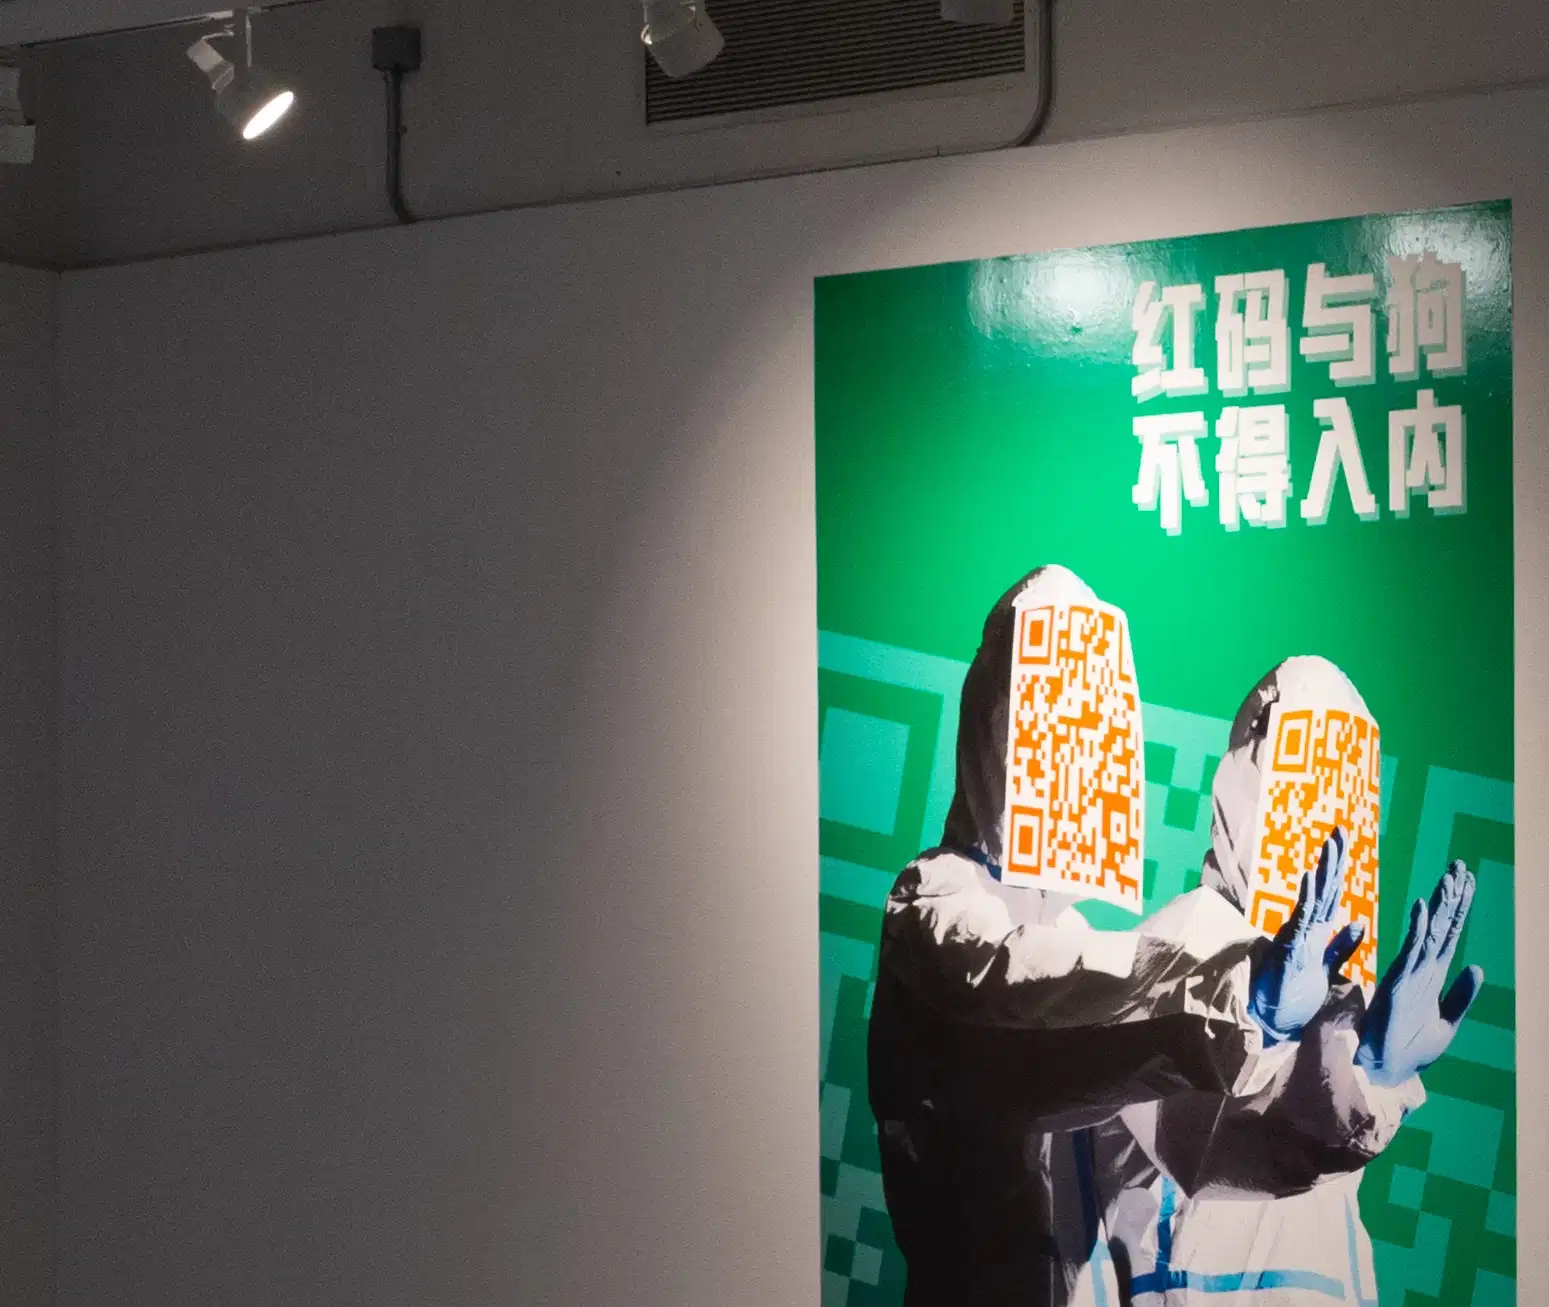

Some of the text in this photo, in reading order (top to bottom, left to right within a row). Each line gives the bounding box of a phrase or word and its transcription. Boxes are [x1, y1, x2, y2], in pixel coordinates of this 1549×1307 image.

[1131, 251, 1467, 403] 红码与狗
[1132, 389, 1468, 536] 不得入内
